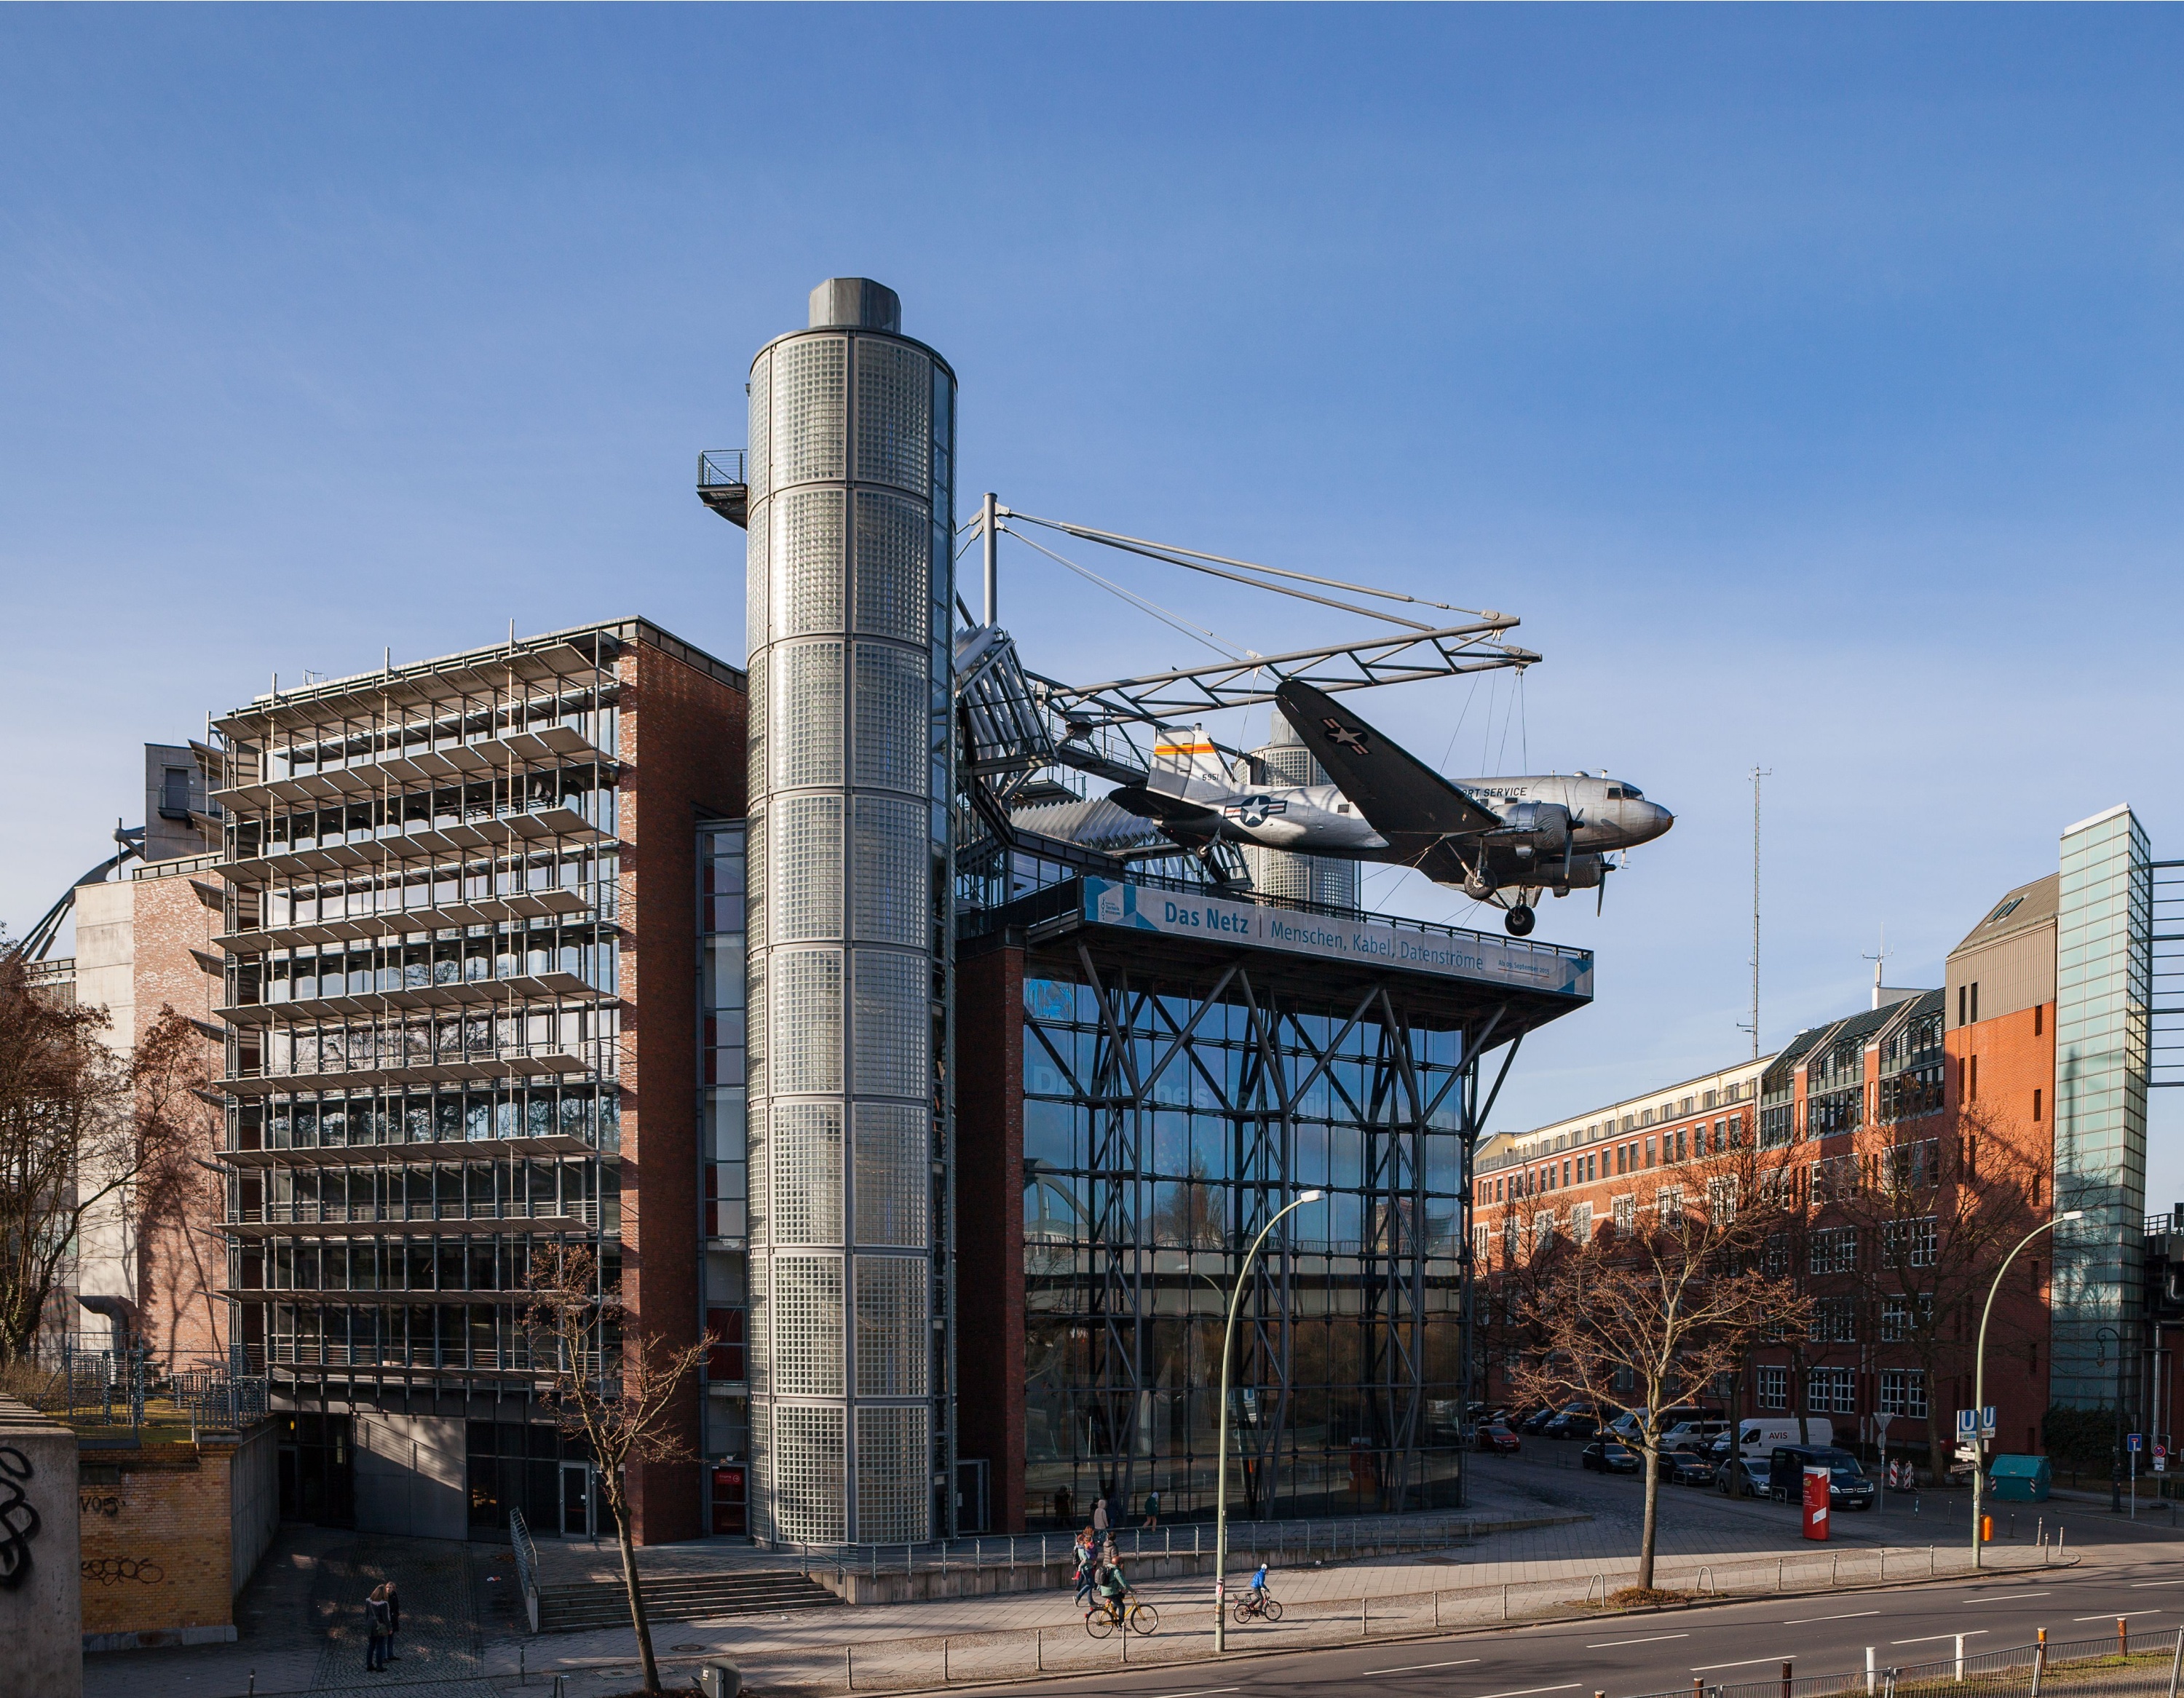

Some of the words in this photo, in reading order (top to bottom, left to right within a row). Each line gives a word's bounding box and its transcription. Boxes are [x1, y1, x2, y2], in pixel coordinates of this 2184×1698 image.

[1484, 787, 1527, 797] SERVICE
[1165, 901, 1200, 927] Das
[1206, 908, 1249, 935] Netz
[1271, 920, 1347, 951] Menschen,
[1353, 933, 1395, 959] Kabel,
[1401, 941, 1483, 970] Datenströme
[1514, 962, 1538, 972] September
[1961, 1411, 1975, 1431] U
[1983, 1407, 1994, 1427] U
[1768, 1432, 1788, 1440] AVIS
